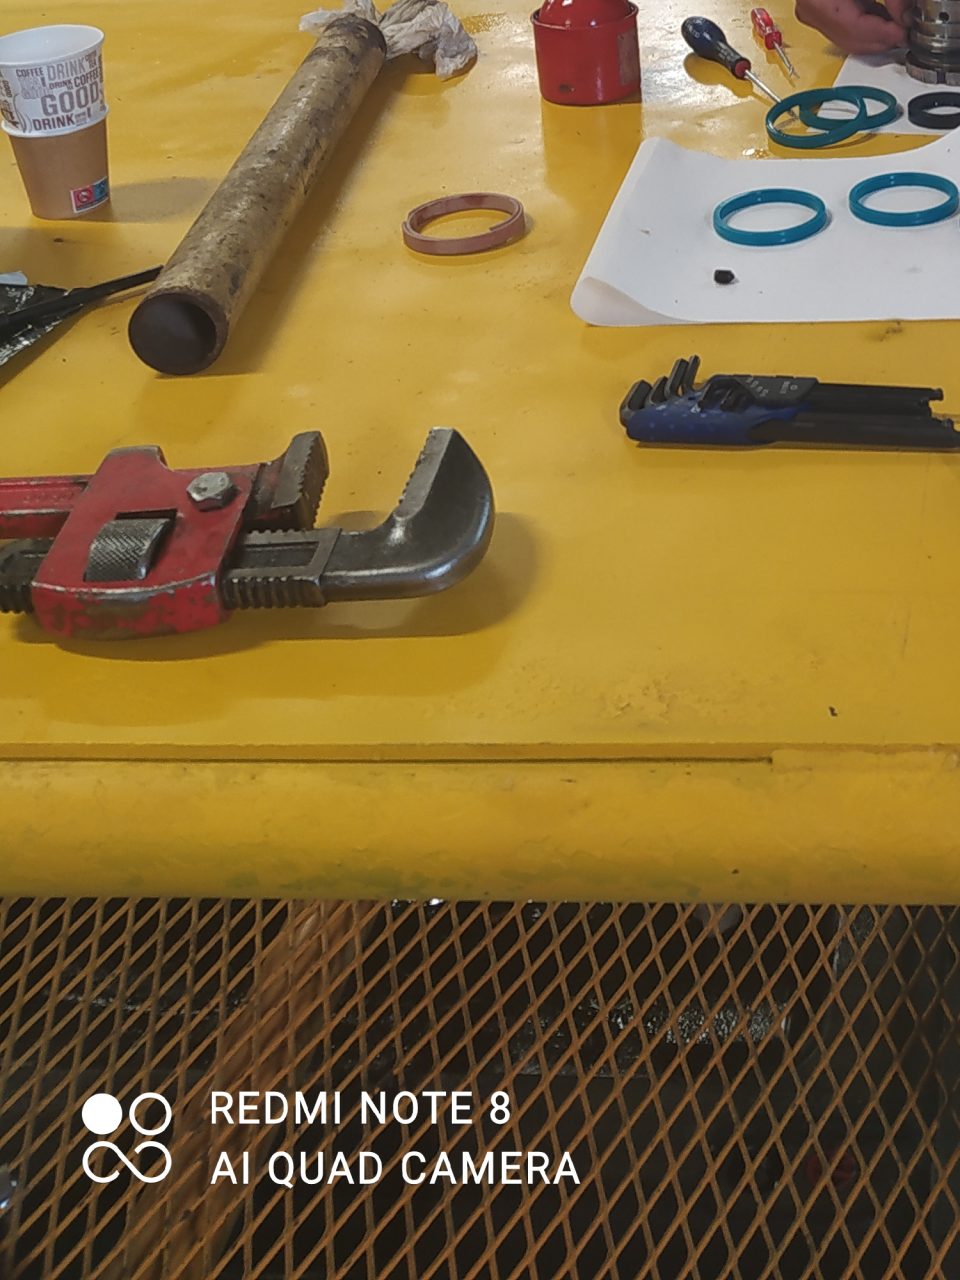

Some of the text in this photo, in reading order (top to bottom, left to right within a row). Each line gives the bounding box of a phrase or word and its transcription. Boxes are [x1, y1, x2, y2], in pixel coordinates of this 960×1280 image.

[16, 67, 44, 78] COFFEE
[47, 57, 85, 81] DRINK
[74, 68, 99, 88] COFFEE
[41, 81, 99, 117] GOOD
[32, 113, 76, 131] DRINK
